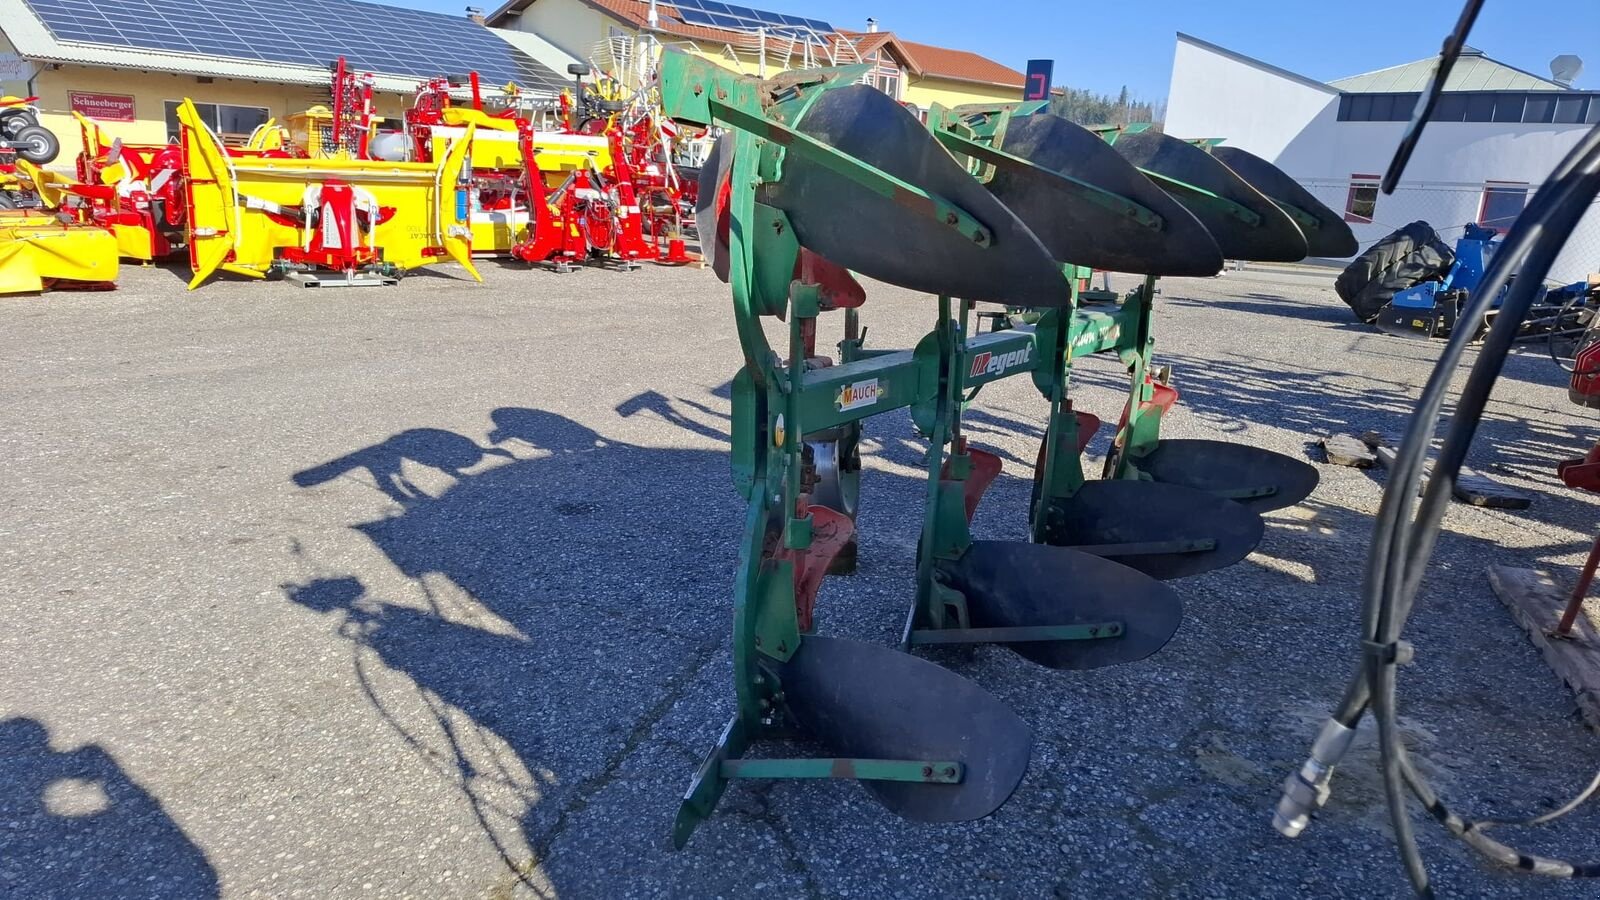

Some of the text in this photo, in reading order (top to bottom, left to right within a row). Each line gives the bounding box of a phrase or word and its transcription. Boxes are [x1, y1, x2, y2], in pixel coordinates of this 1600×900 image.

[73, 97, 132, 109] Schneeberger
[970, 341, 1033, 378] Regent
[843, 384, 876, 404] MAUCH
